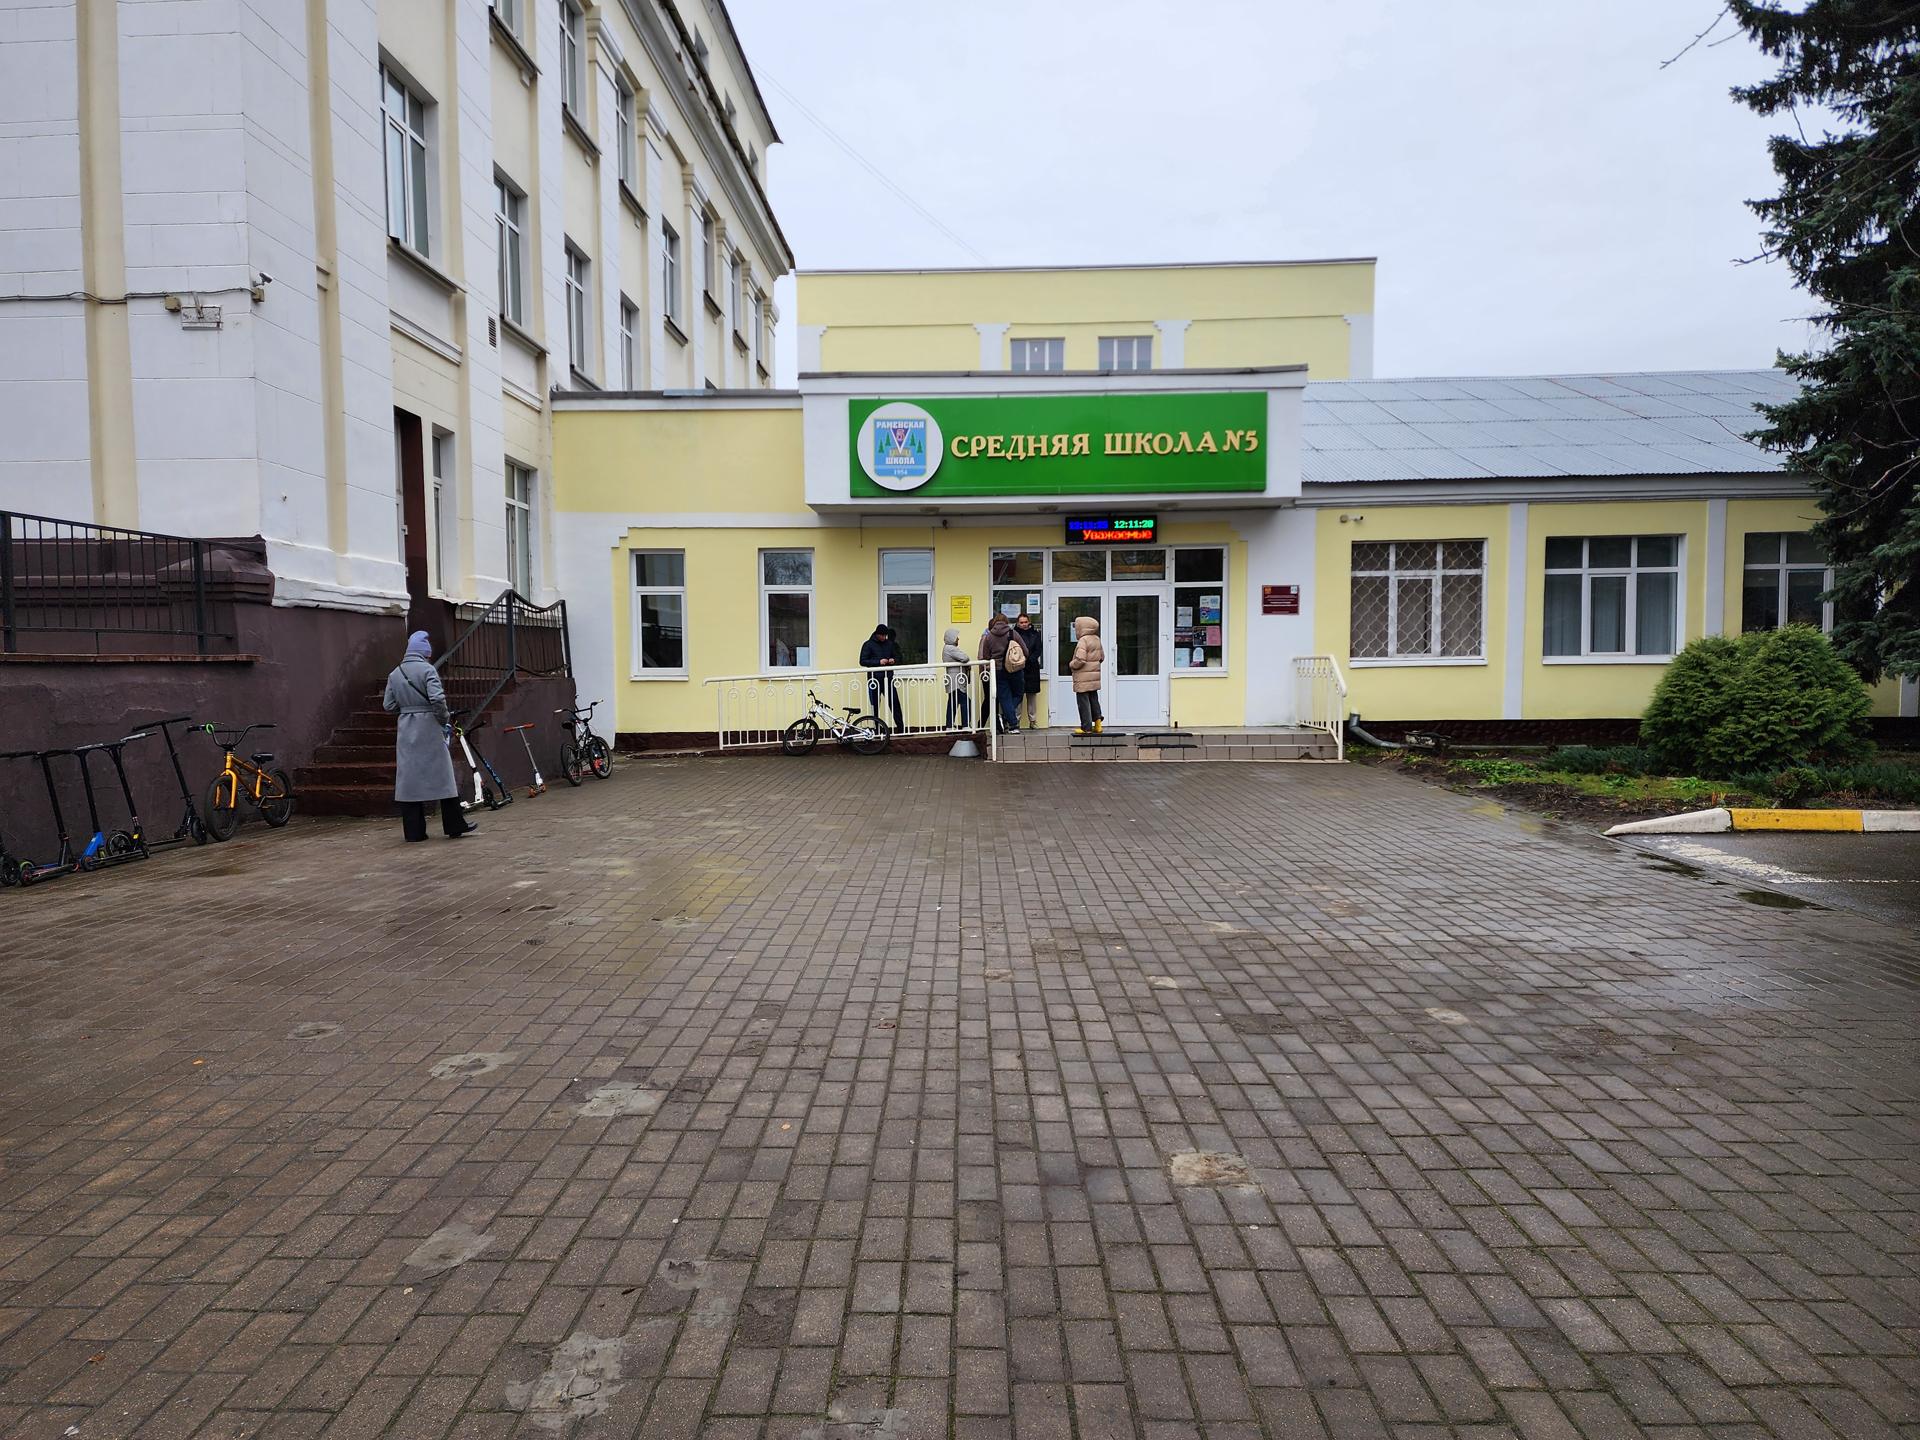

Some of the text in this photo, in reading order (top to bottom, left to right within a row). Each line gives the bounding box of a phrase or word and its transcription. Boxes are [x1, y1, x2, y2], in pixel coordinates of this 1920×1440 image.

[876, 421, 924, 429] РАМЕНСКАЯ
[951, 433, 1090, 460] СРЕДНЯЯ
[1104, 430, 1218, 455] ШКОЛА
[885, 456, 915, 465] ШКОЛА
